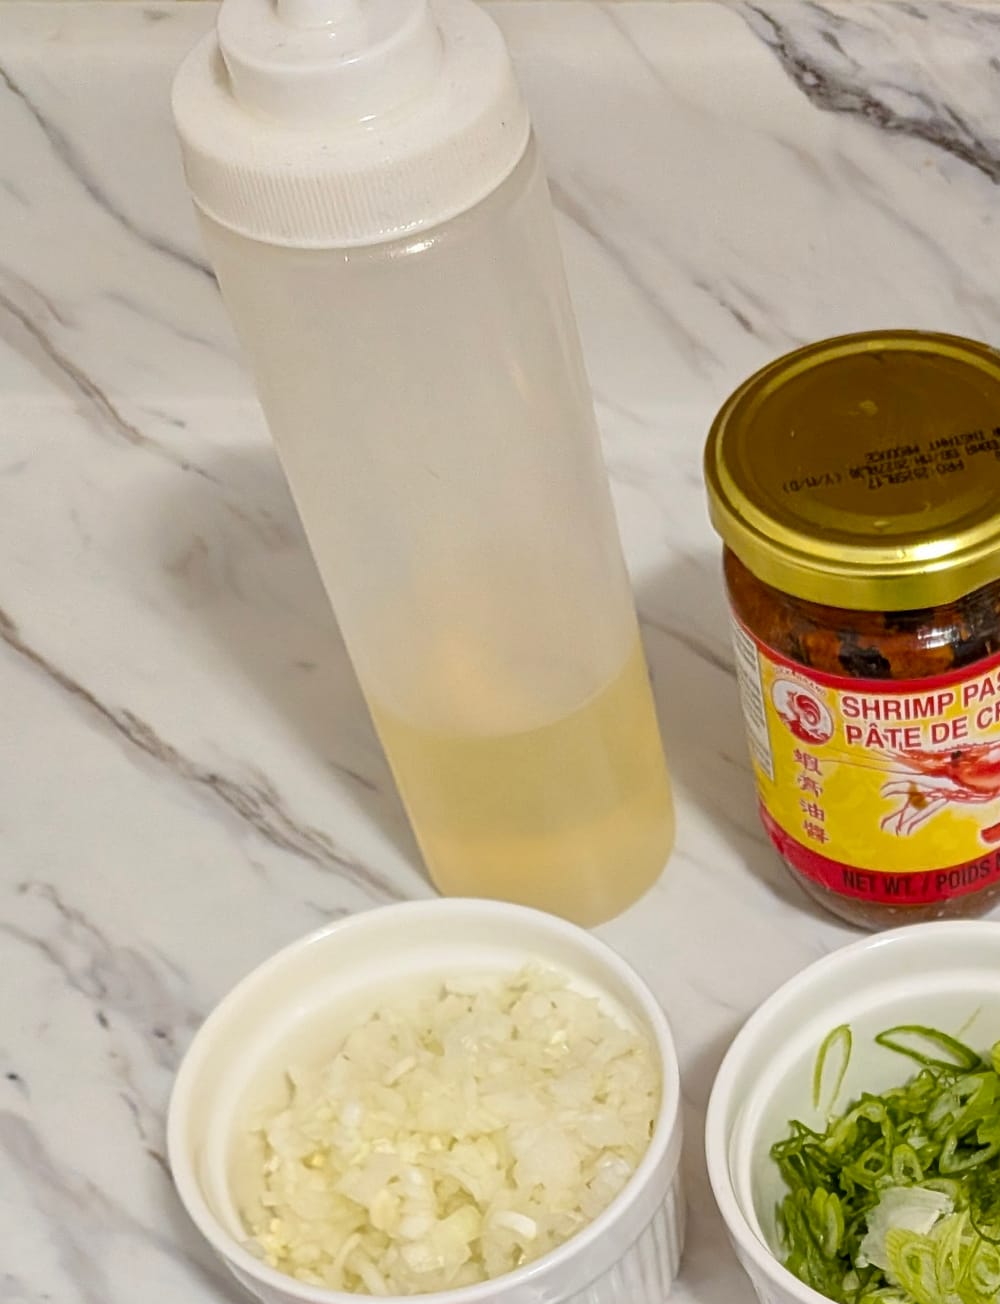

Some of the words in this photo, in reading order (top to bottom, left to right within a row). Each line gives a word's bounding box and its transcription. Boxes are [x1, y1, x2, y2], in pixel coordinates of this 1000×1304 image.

[842, 692, 954, 721] SHRIMP
[846, 723, 922, 749] PÂTE
[932, 717, 969, 745] DE
[842, 870, 875, 892] NET
[936, 859, 991, 892] POIDS
